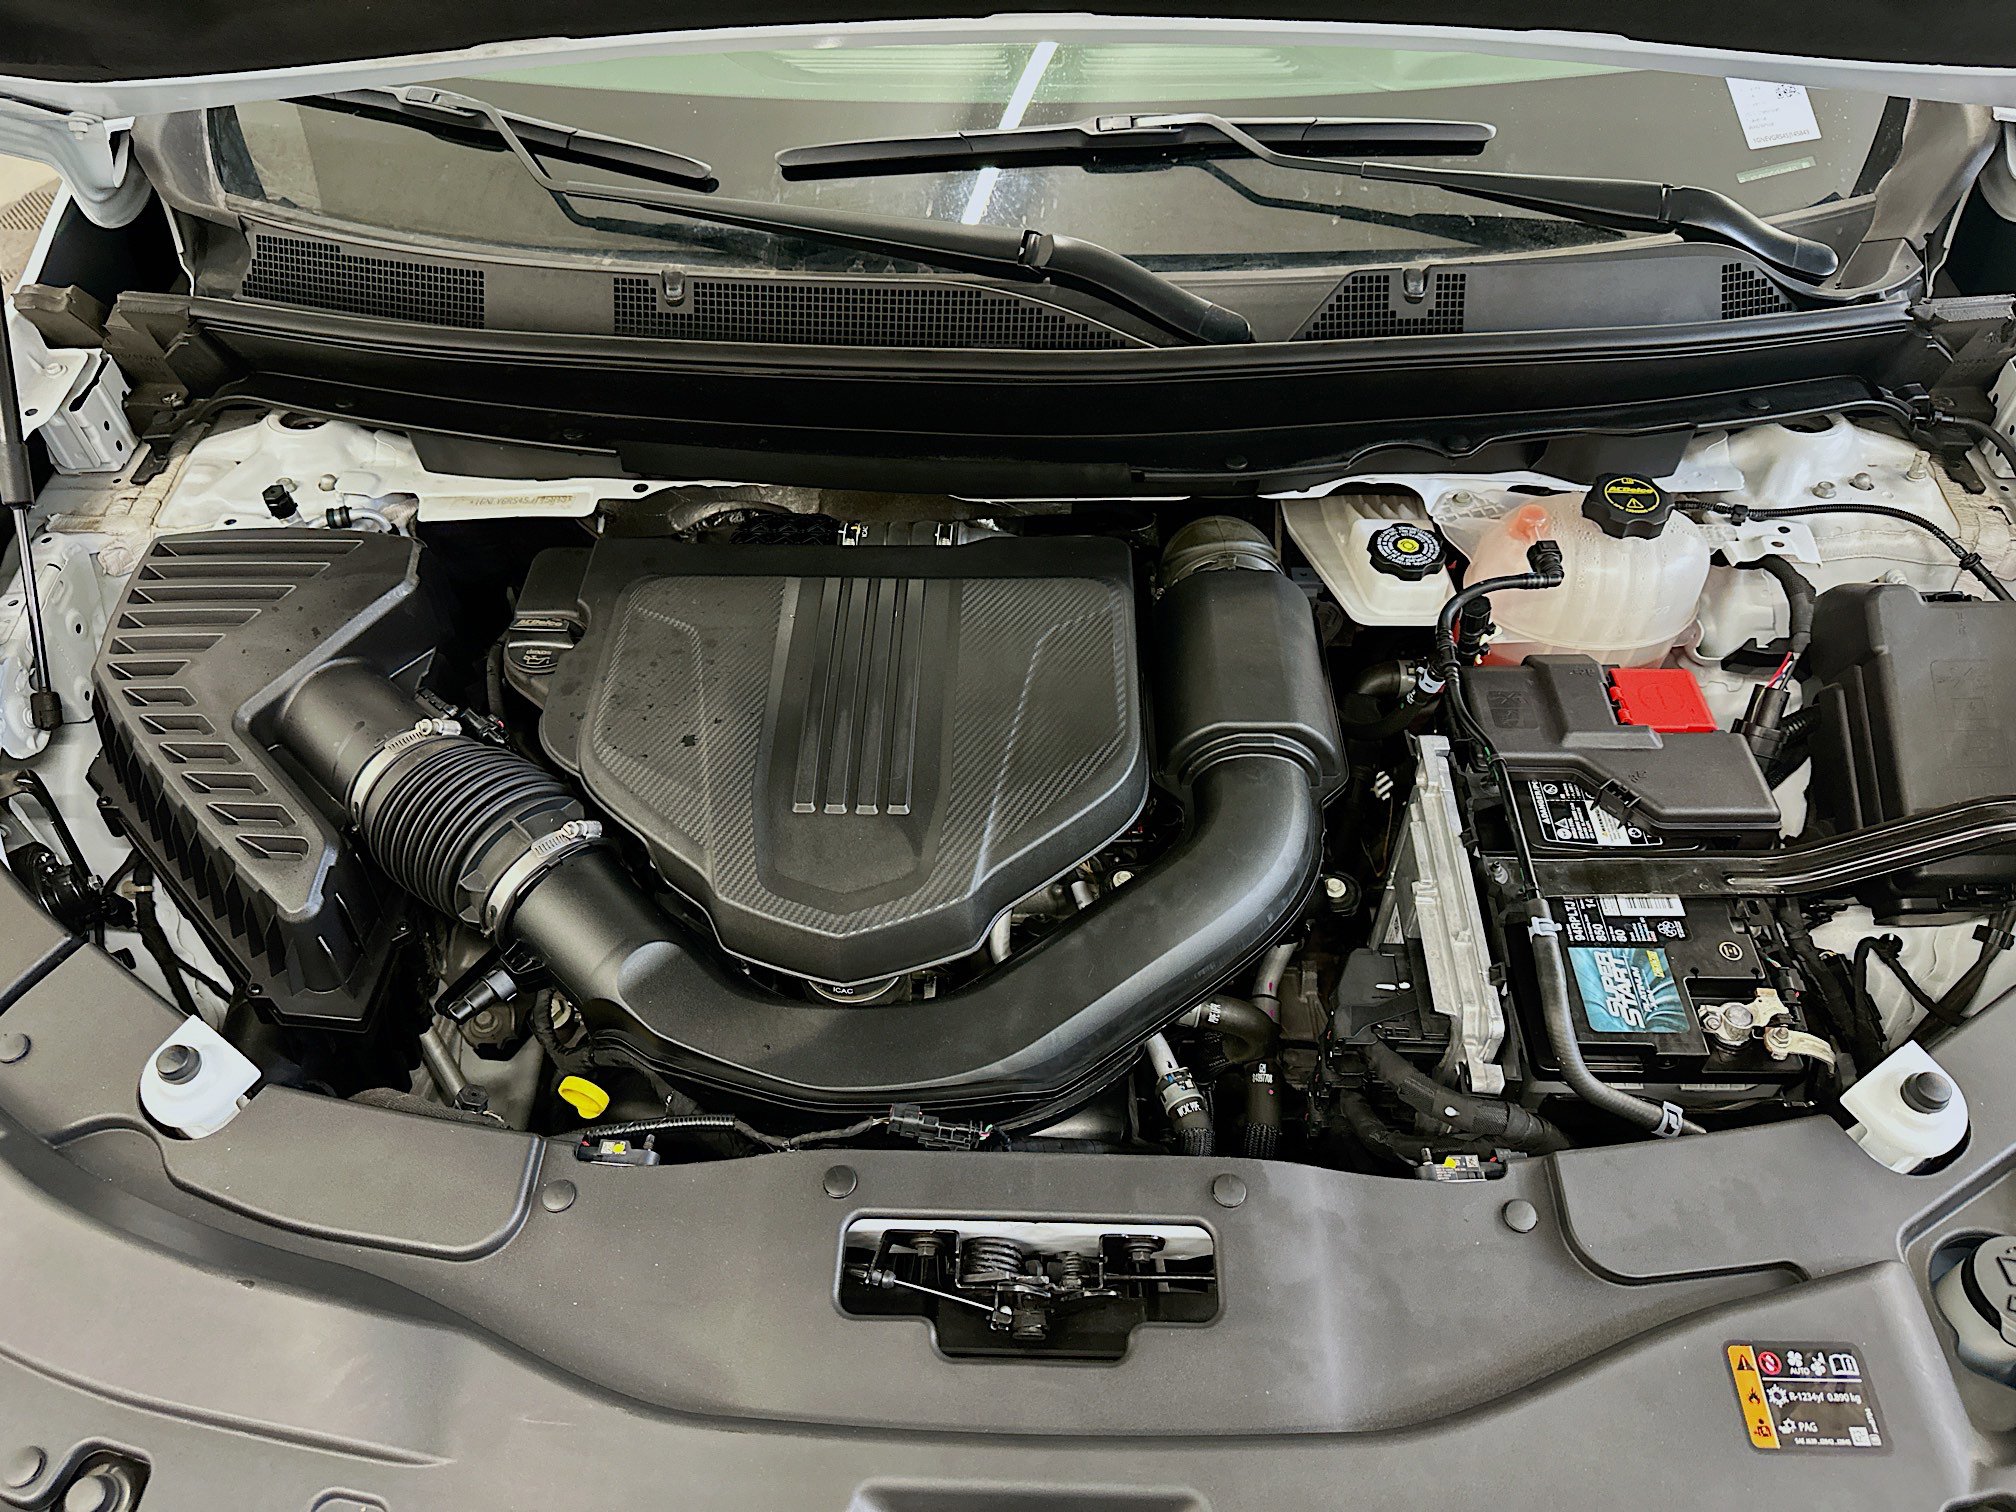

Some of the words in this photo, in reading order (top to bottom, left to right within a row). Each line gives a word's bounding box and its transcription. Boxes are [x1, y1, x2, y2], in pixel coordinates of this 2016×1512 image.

[1591, 923, 1607, 941] 850
[1614, 929, 1628, 942] 80
[1594, 951, 1621, 1017] SUPER
[1610, 951, 1645, 1029] START
[1790, 1367, 1810, 1375] AUTO
[1798, 1421, 1818, 1432] PAG
